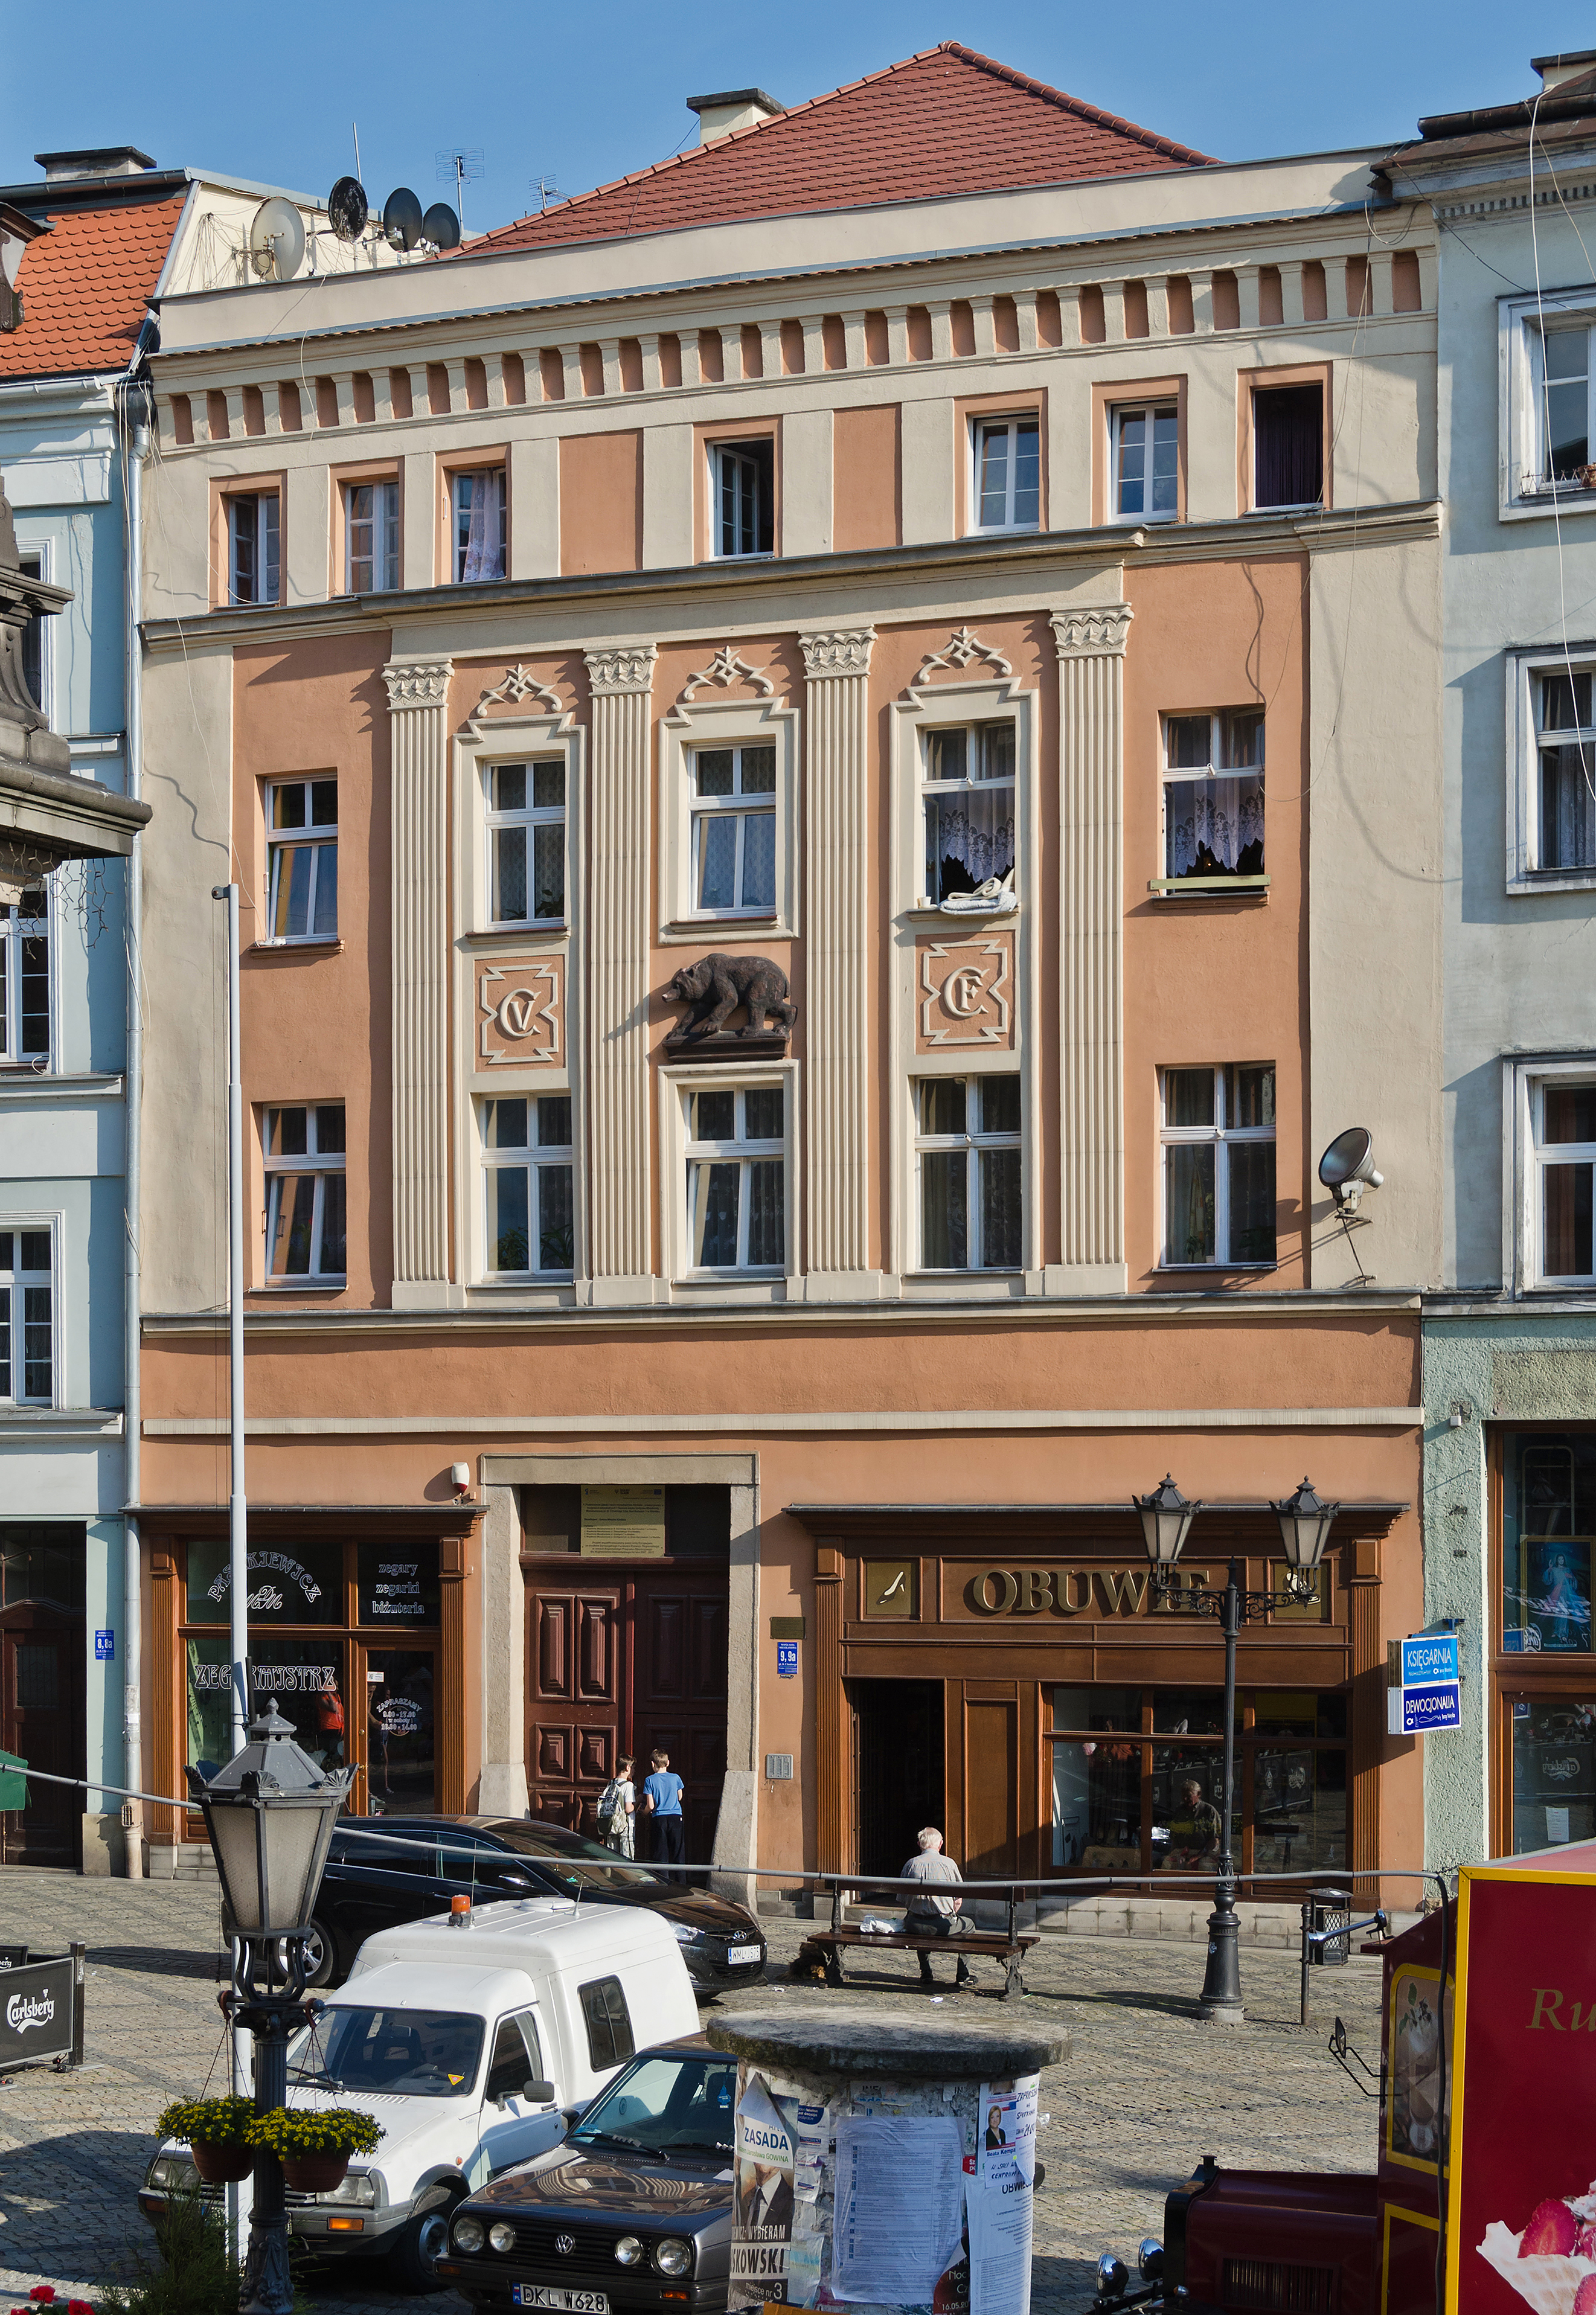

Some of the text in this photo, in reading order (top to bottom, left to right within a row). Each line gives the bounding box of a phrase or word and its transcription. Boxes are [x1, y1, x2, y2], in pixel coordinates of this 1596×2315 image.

[379, 1564, 418, 1576] zegary
[376, 1581, 420, 1596] zegarki
[372, 1601, 425, 1614] biżuteria
[105, 1638, 112, 1648] 8a
[788, 1650, 796, 1662] 9a
[1408, 1647, 1452, 1670] KSIĘGARNIA
[194, 1664, 336, 1691] ZEGRMISTRZ
[376, 1698, 422, 1712] ZAPRASZAMY
[1406, 1695, 1455, 1714] DEWOCJONALIA
[7, 1993, 55, 2029] Carlsberg
[745, 2127, 789, 2151] ZASADA
[747, 2148, 765, 2159] Jarosława
[766, 2153, 789, 2162] GOWINA
[748, 2224, 786, 2240] WYBIERAM
[732, 2248, 784, 2273] SKOWSKI
[523, 2285, 604, 2311] DKL W628
[746, 2282, 764, 2294] miejsce
[774, 2282, 782, 2299] 3
